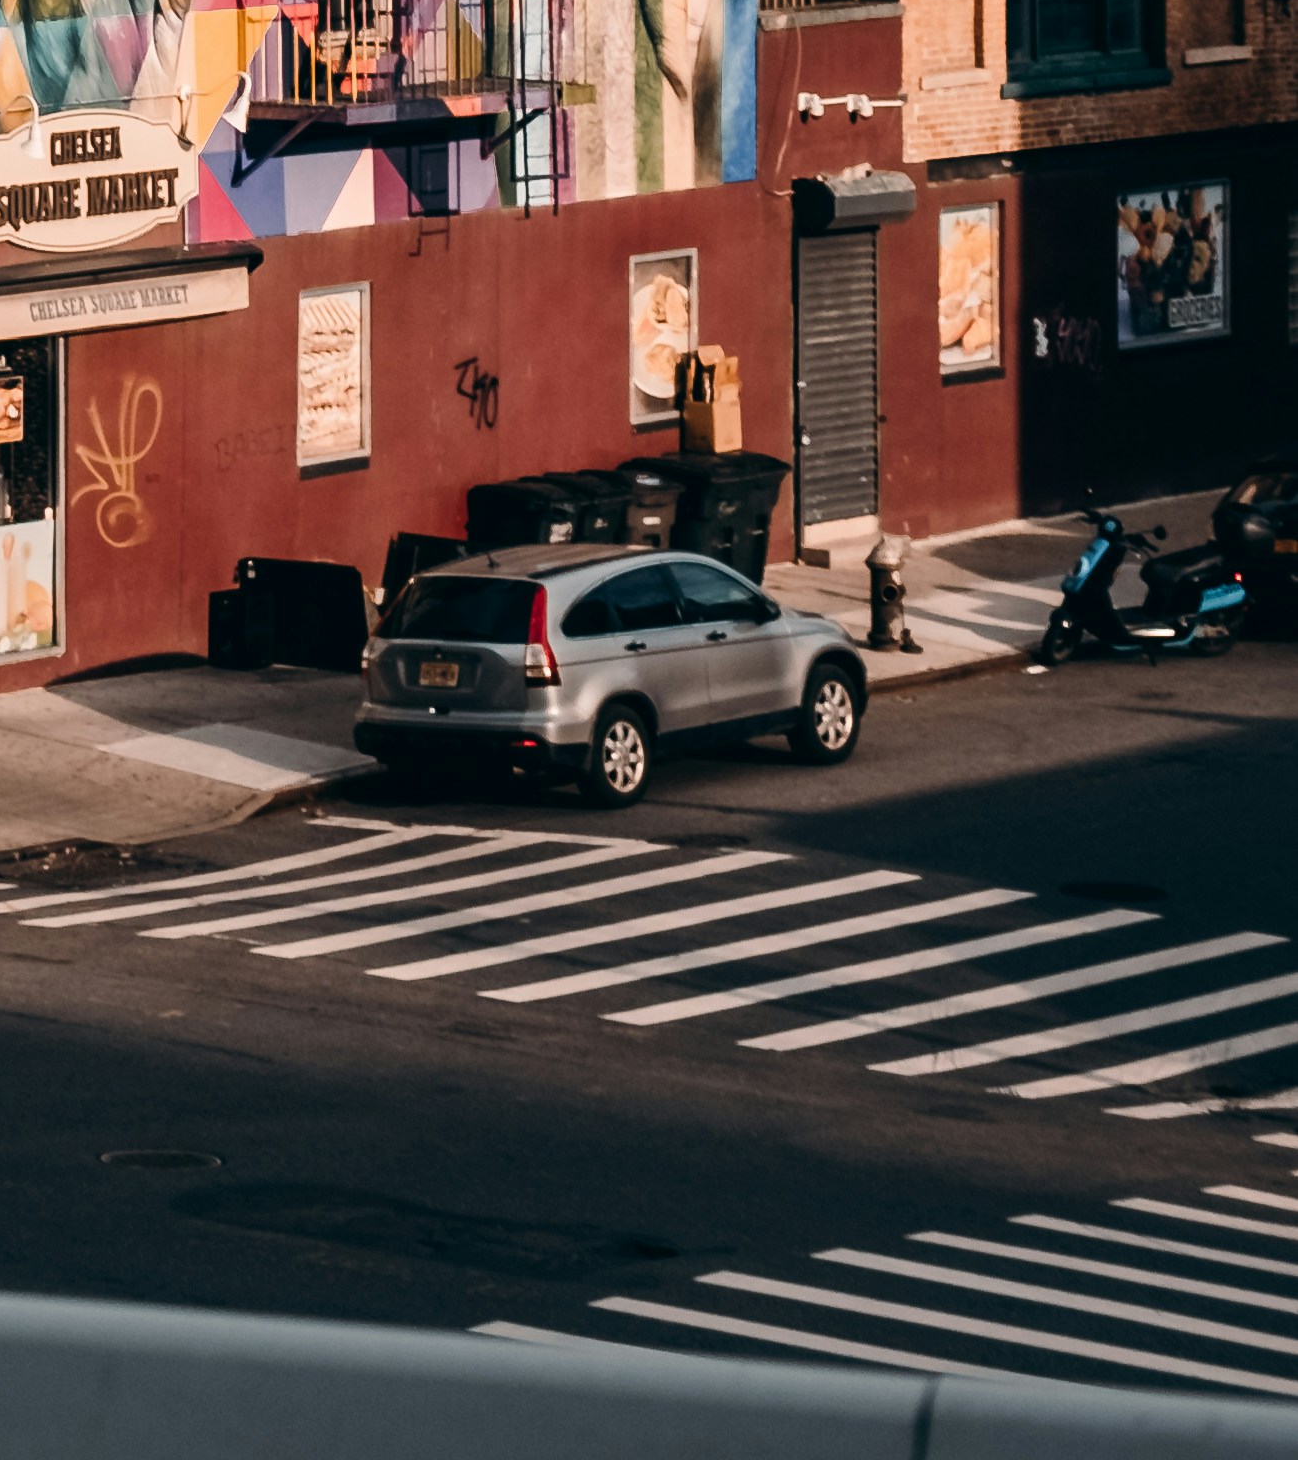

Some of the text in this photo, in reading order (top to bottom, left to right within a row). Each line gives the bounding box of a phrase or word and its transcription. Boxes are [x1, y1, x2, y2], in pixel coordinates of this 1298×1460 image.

[51, 127, 122, 166] CHELSEA
[86, 168, 178, 217] MARKET
[29, 298, 87, 322] CHELSEA
[92, 291, 136, 314] SQUARE
[141, 284, 188, 307] MARKET
